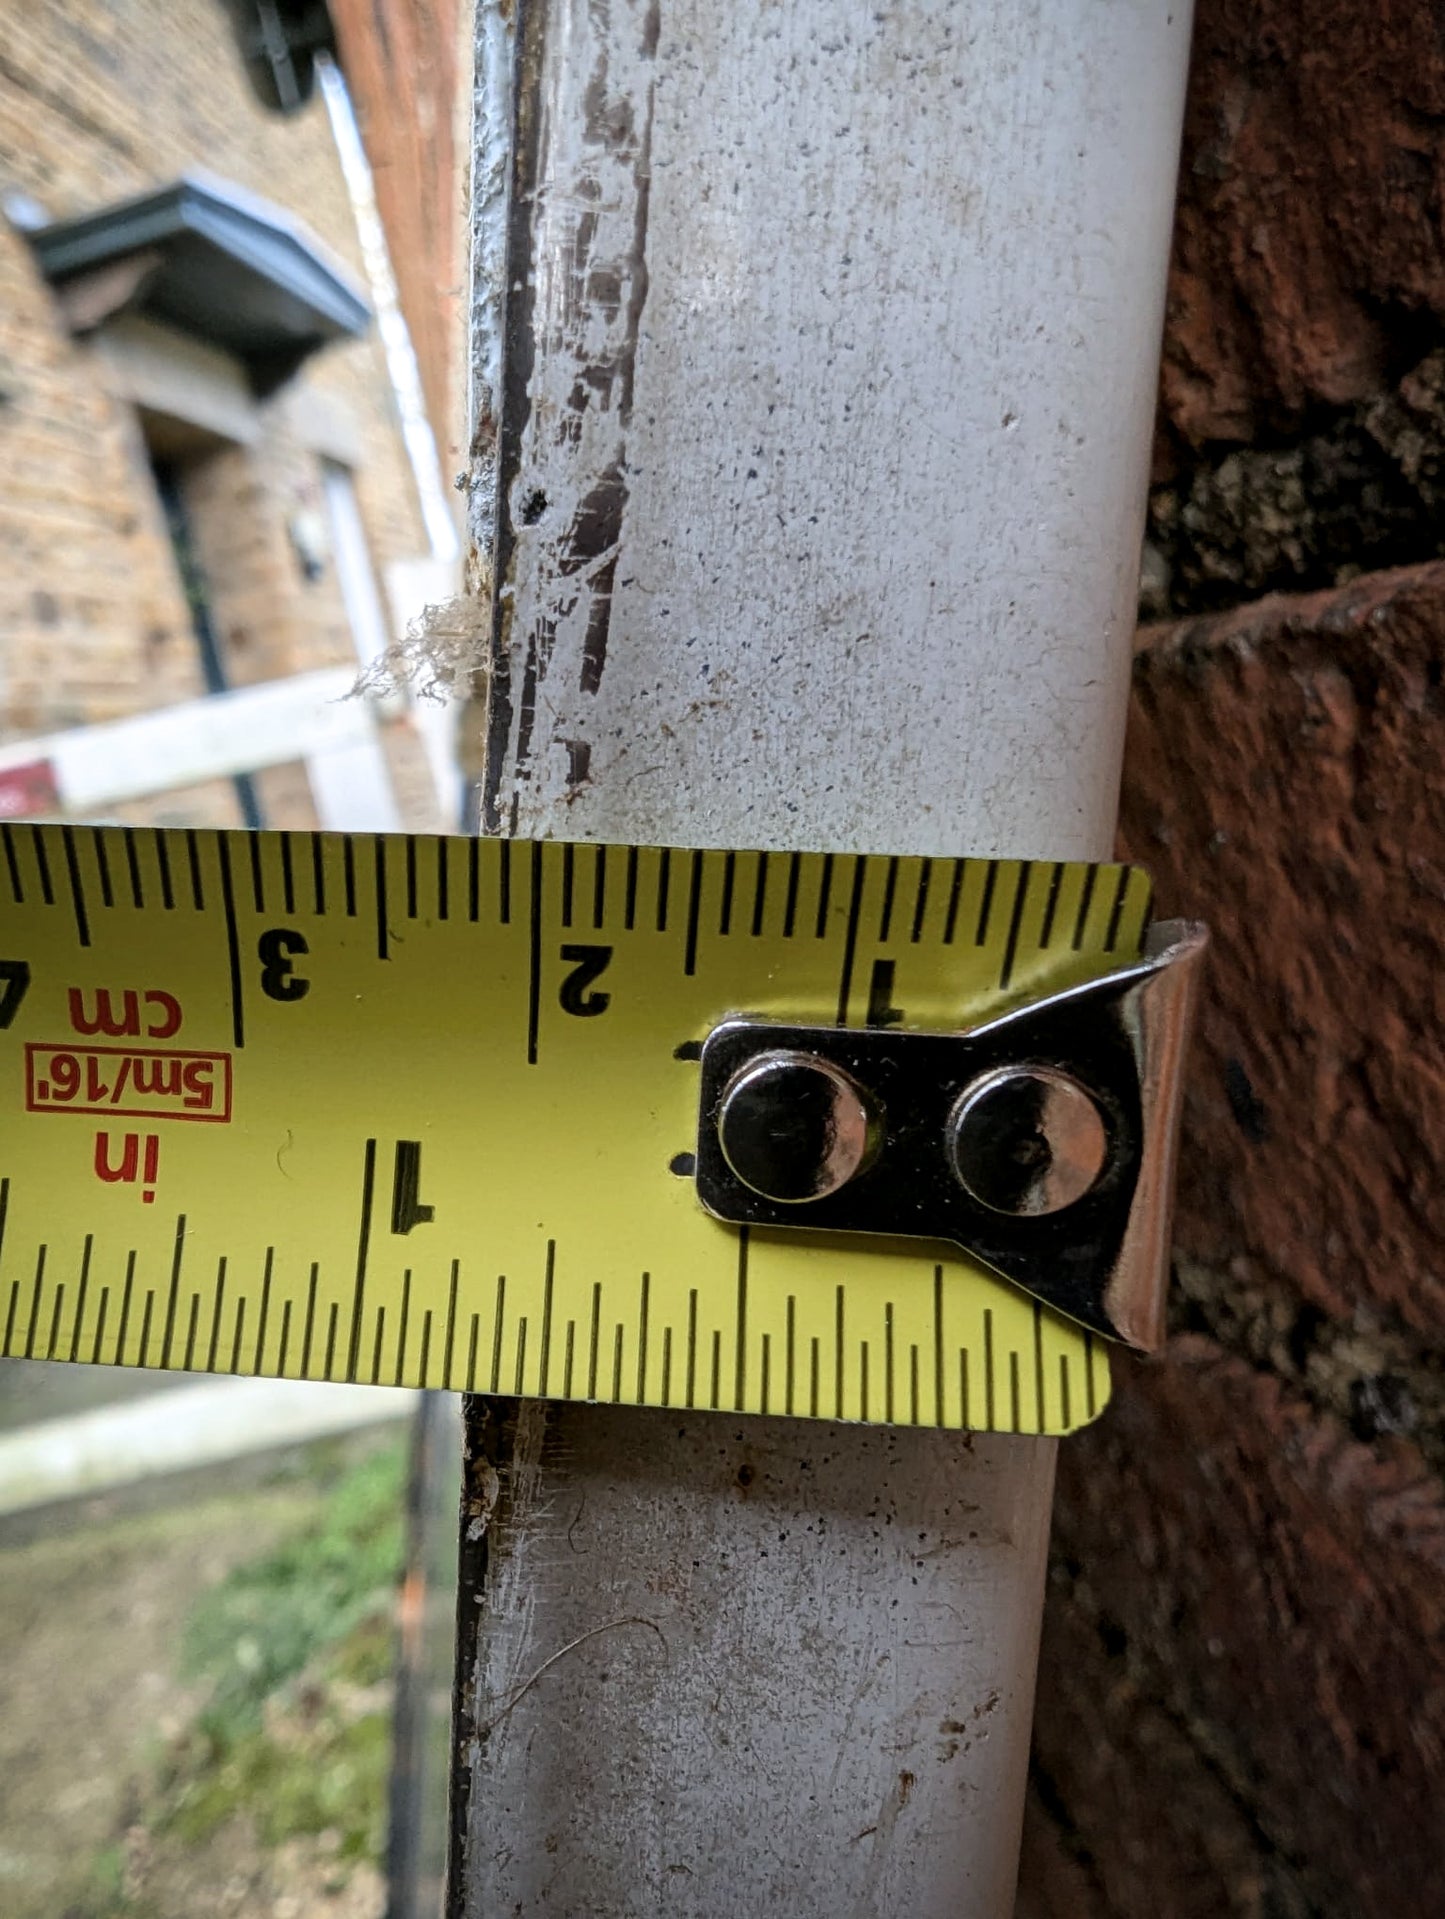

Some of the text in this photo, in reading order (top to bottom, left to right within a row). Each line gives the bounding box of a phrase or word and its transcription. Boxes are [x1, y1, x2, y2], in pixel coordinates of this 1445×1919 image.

[258, 929, 310, 1001] 3
[559, 944, 613, 1017] 2
[867, 959, 905, 1029] 1
[68, 987, 182, 1039] cm
[37, 1054, 213, 1109] 5m/16'
[94, 1132, 159, 1203] in
[391, 1141, 435, 1235] 1
